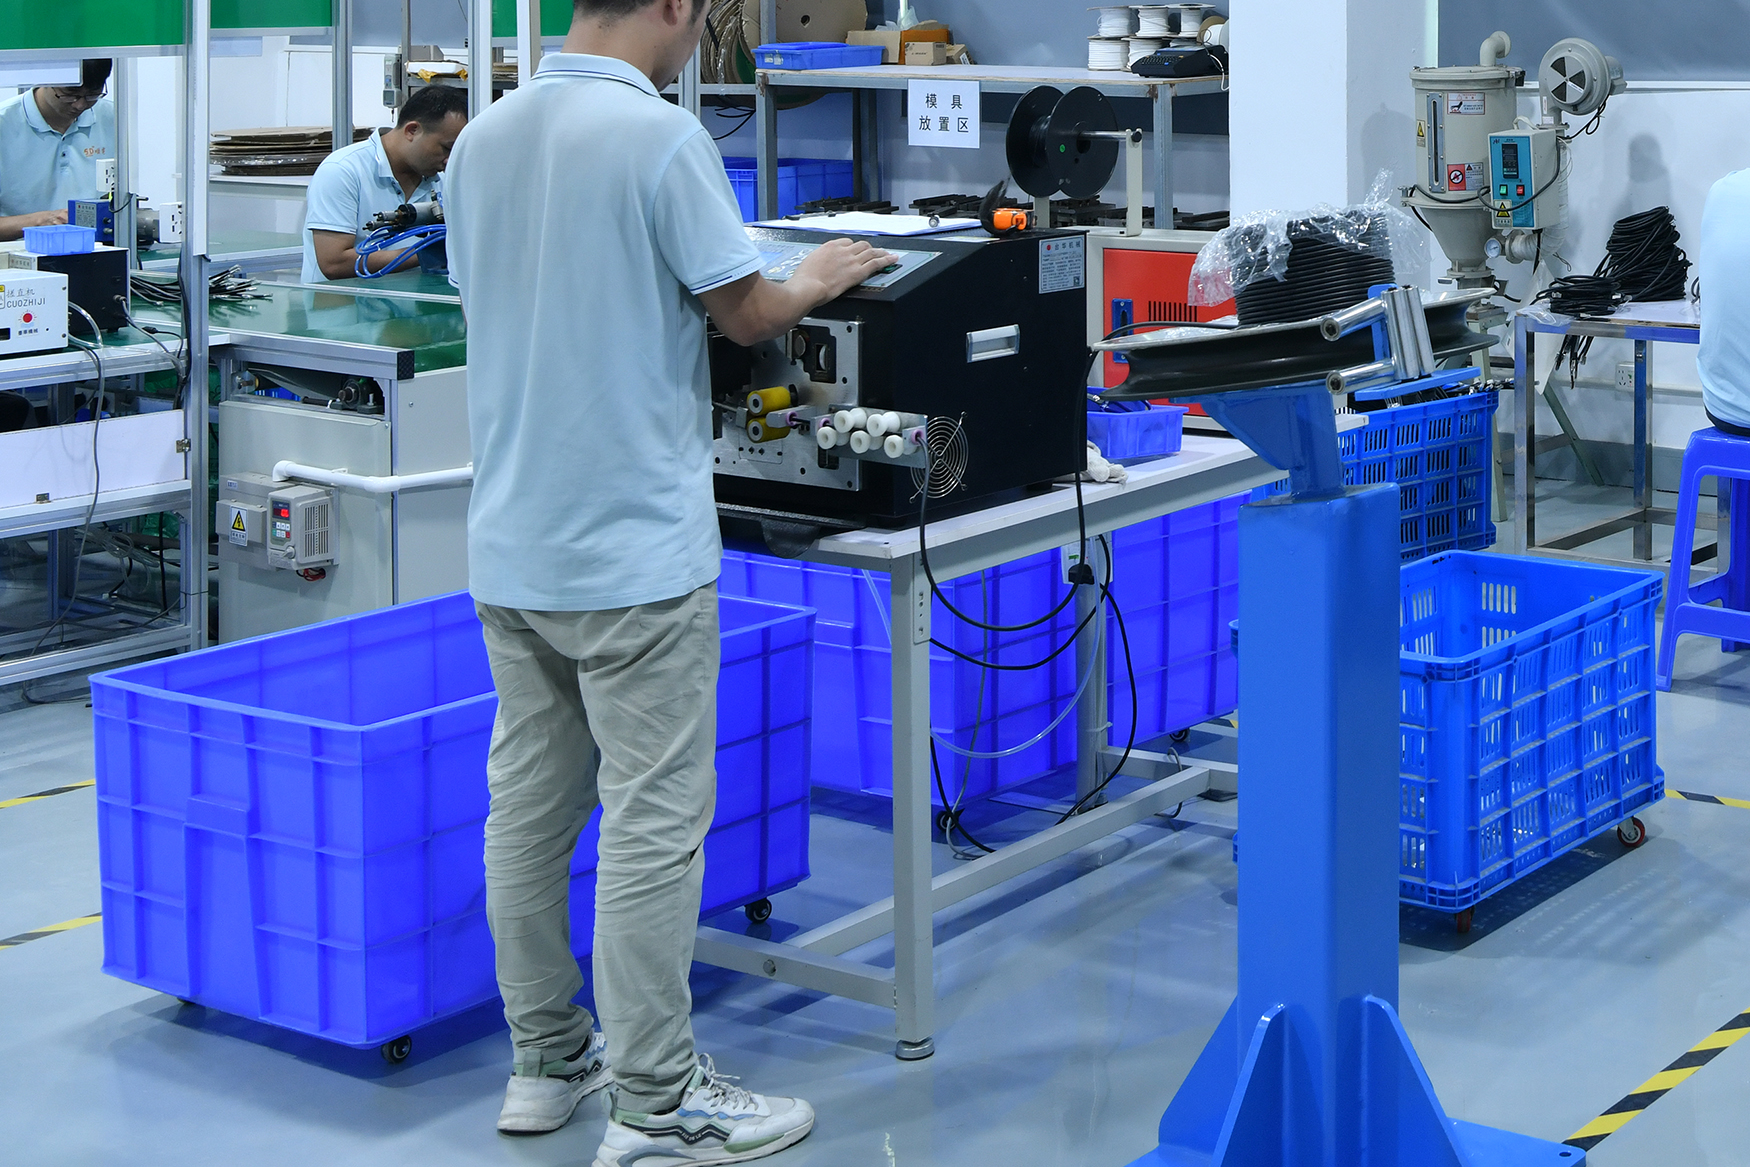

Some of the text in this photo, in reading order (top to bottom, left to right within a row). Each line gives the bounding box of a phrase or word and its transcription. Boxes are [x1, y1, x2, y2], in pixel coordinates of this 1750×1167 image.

[925, 93, 963, 109] 模具
[918, 115, 969, 133] 放置区
[6, 297, 46, 308] CUOZHIJI
